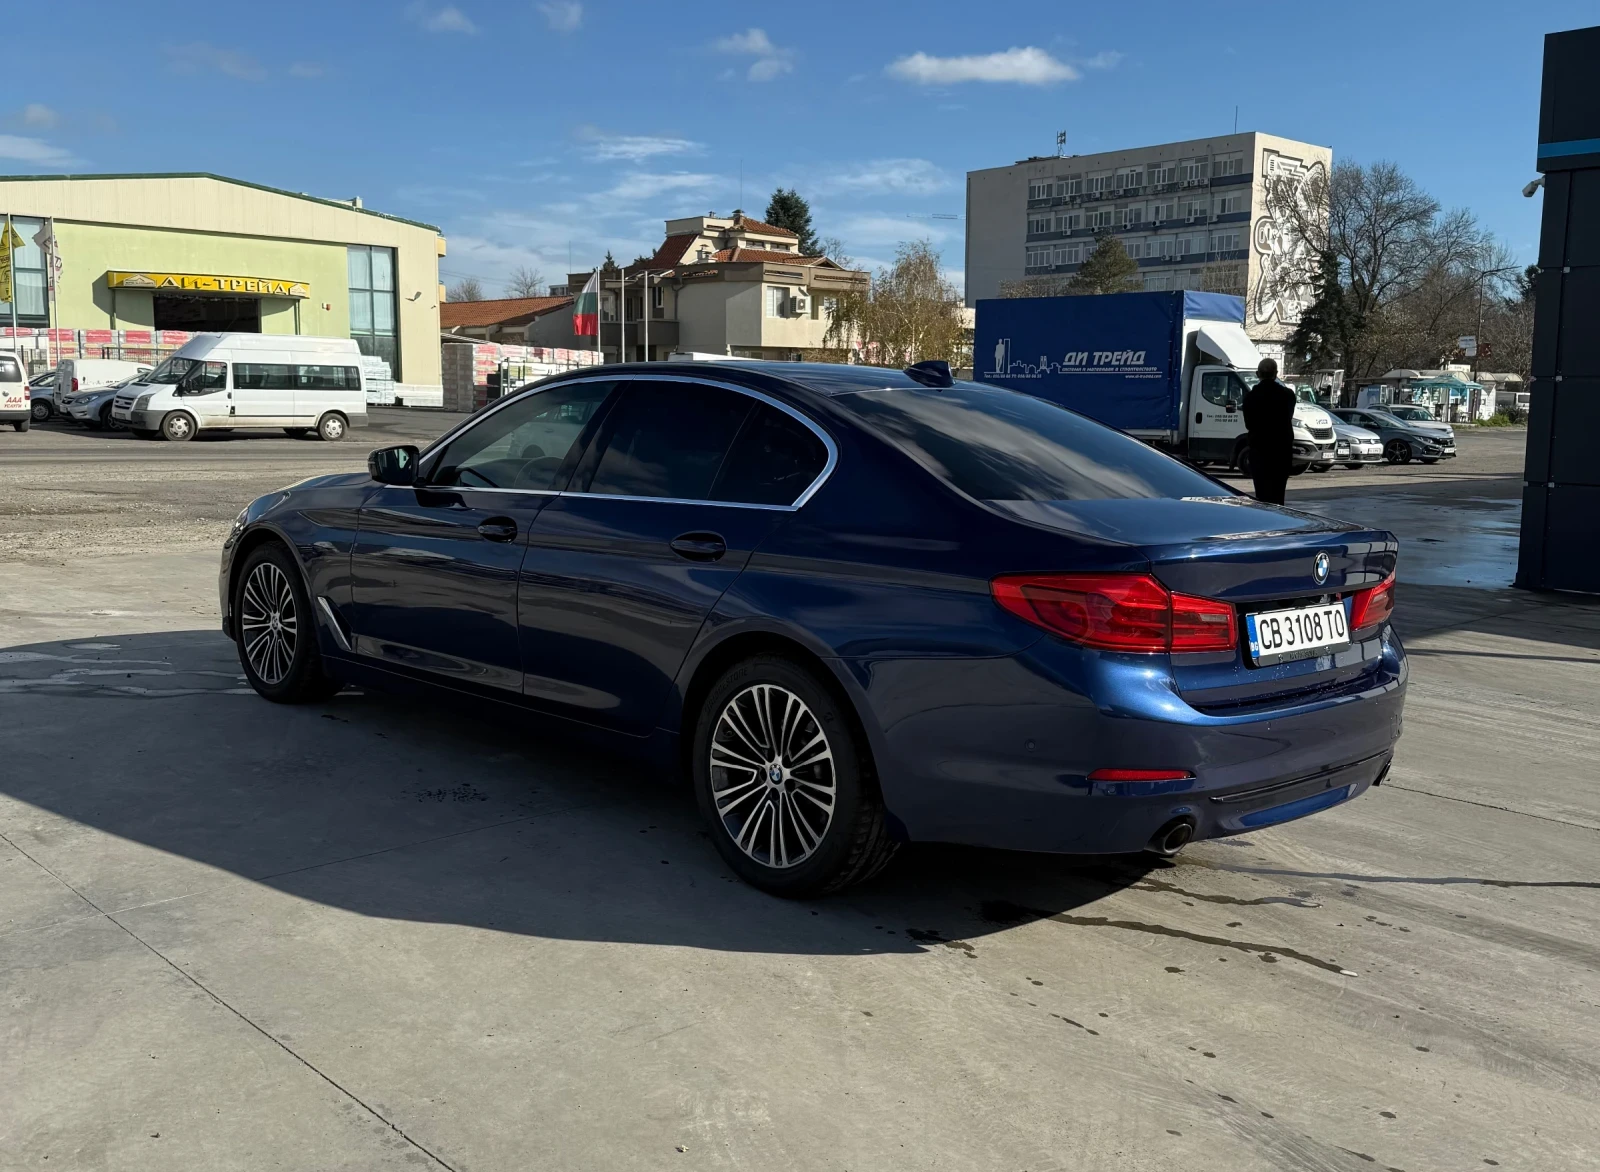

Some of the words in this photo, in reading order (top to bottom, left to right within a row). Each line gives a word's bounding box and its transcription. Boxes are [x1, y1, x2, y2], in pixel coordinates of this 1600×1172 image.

[161, 276, 287, 295] ДИ-ТРЕЙД
[1062, 352, 1089, 366] ДИ
[1093, 350, 1146, 365] ТРЕЙД
[1285, 612, 1324, 645] 3108
